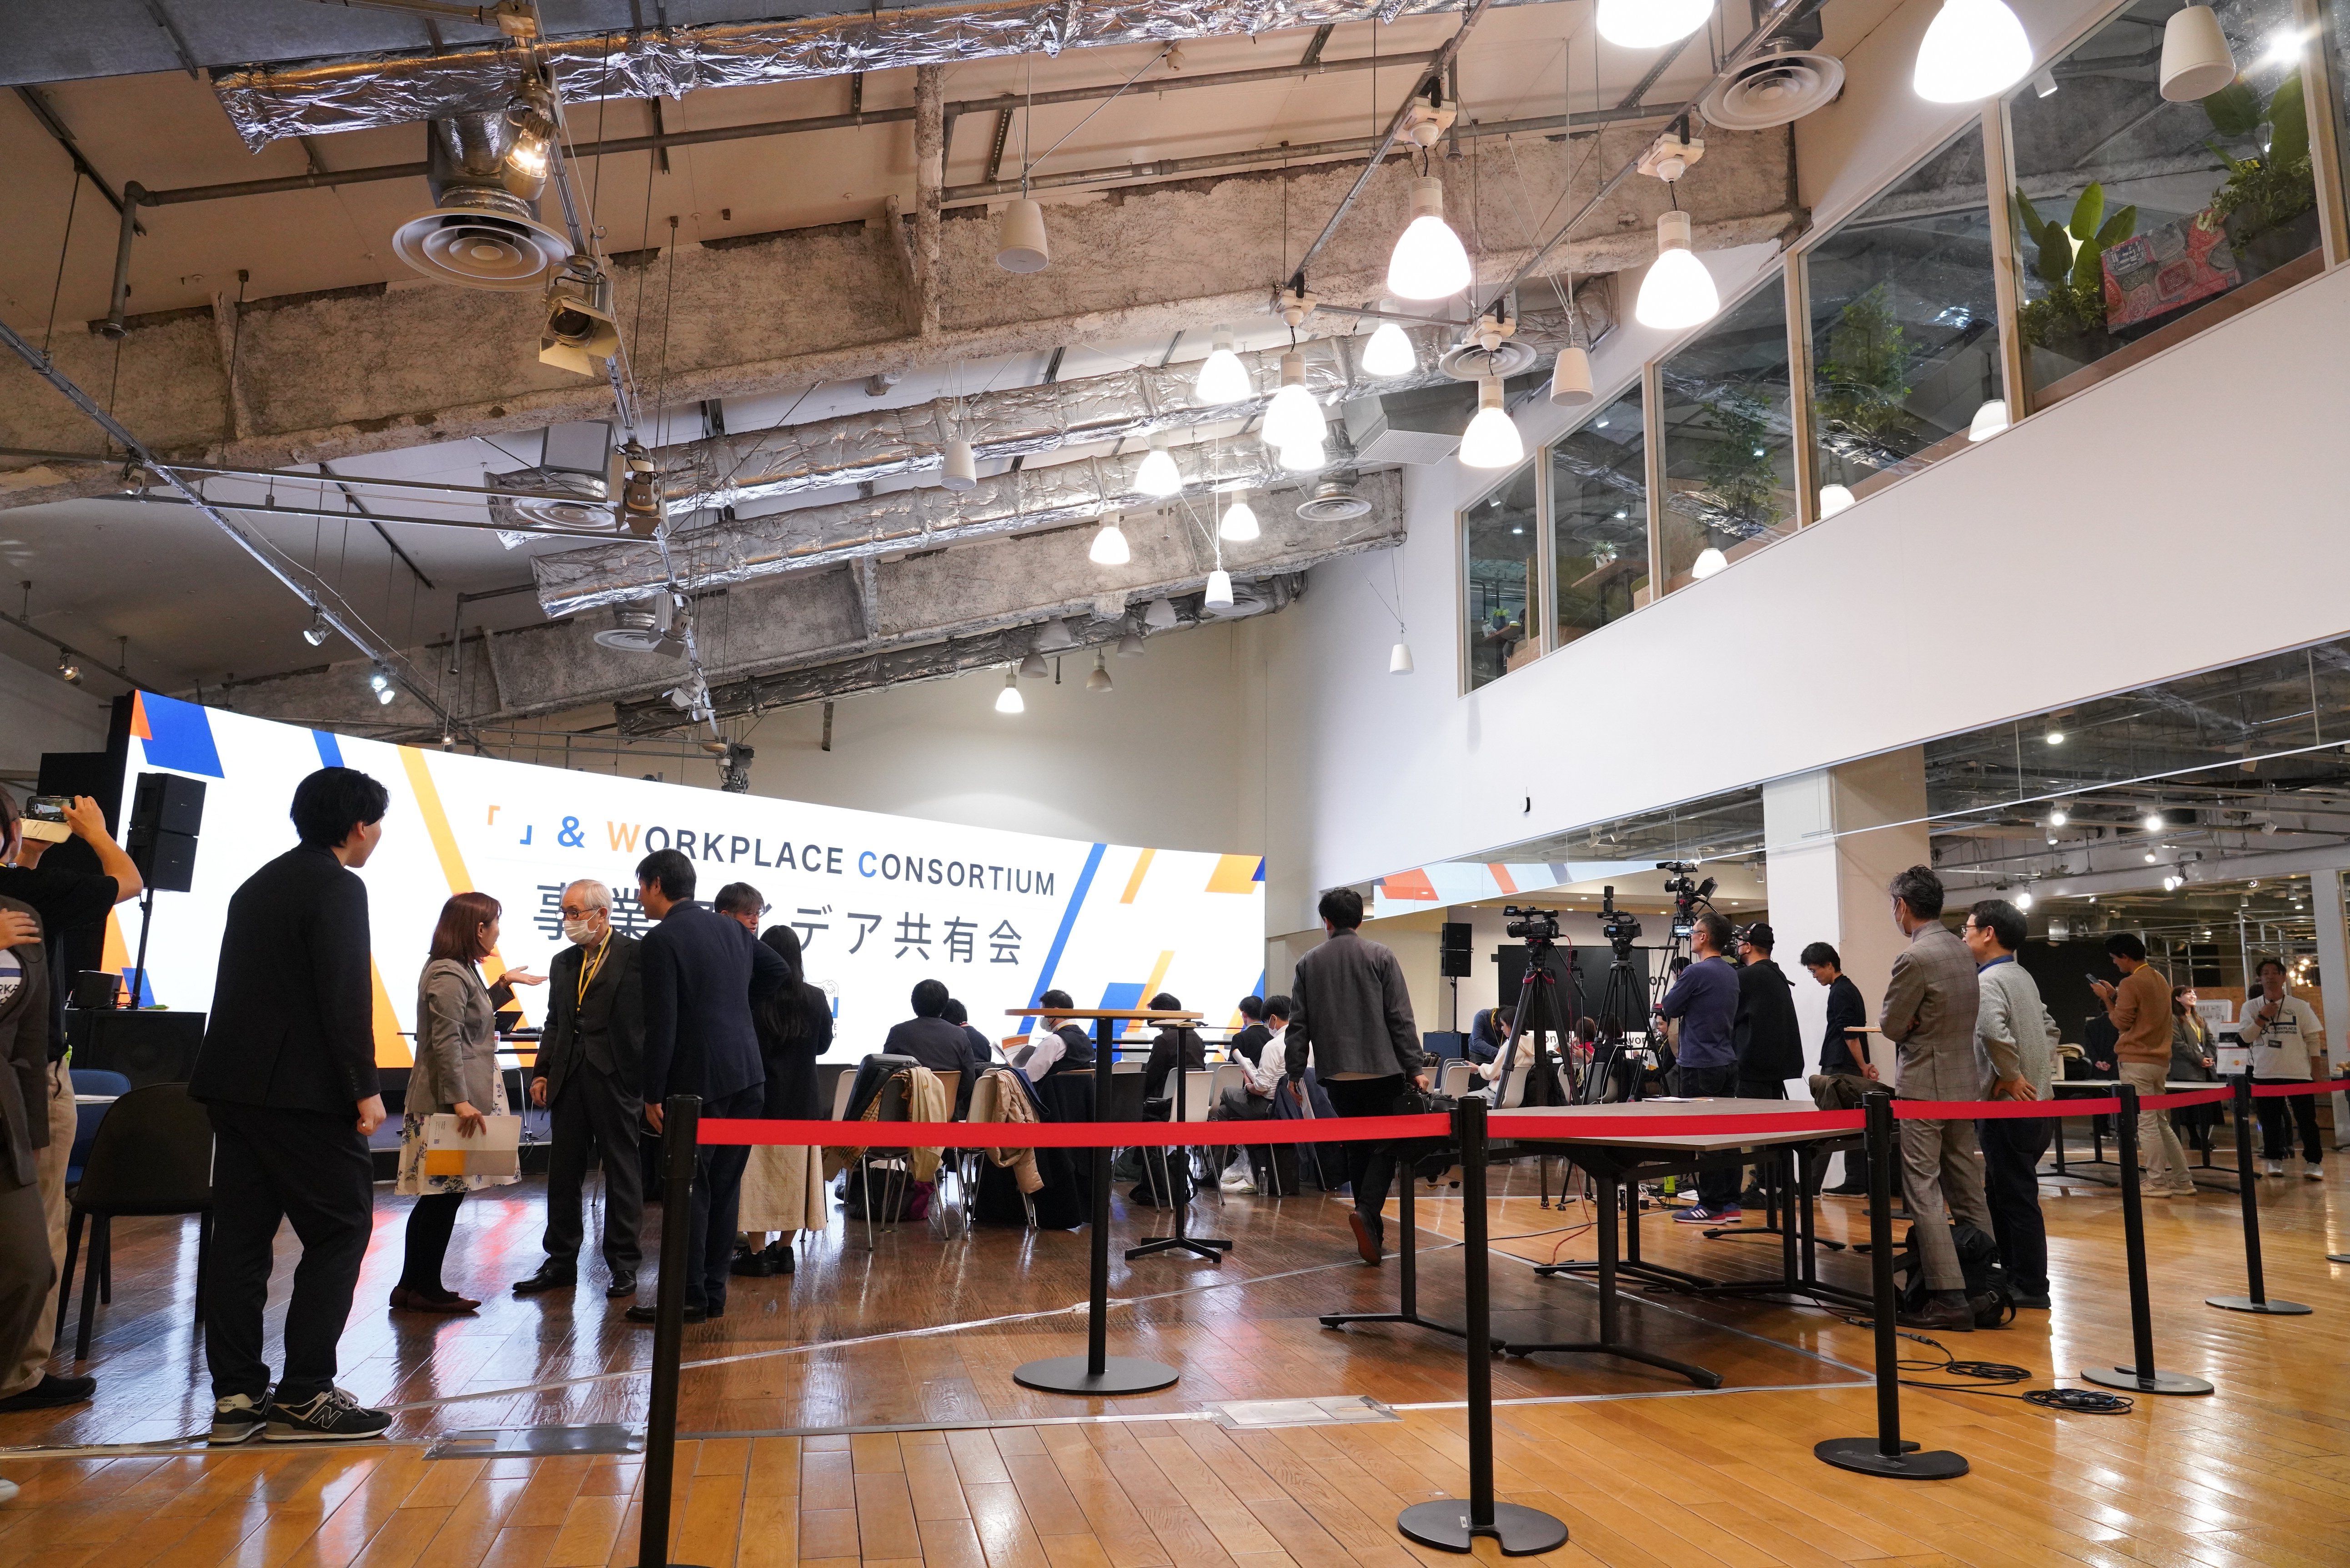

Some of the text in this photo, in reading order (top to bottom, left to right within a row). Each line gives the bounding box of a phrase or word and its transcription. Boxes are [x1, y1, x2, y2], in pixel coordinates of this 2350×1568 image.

[557, 816, 585, 848] &
[608, 821, 843, 874] WORKPLACE
[858, 851, 1054, 896] CONSORTIUM
